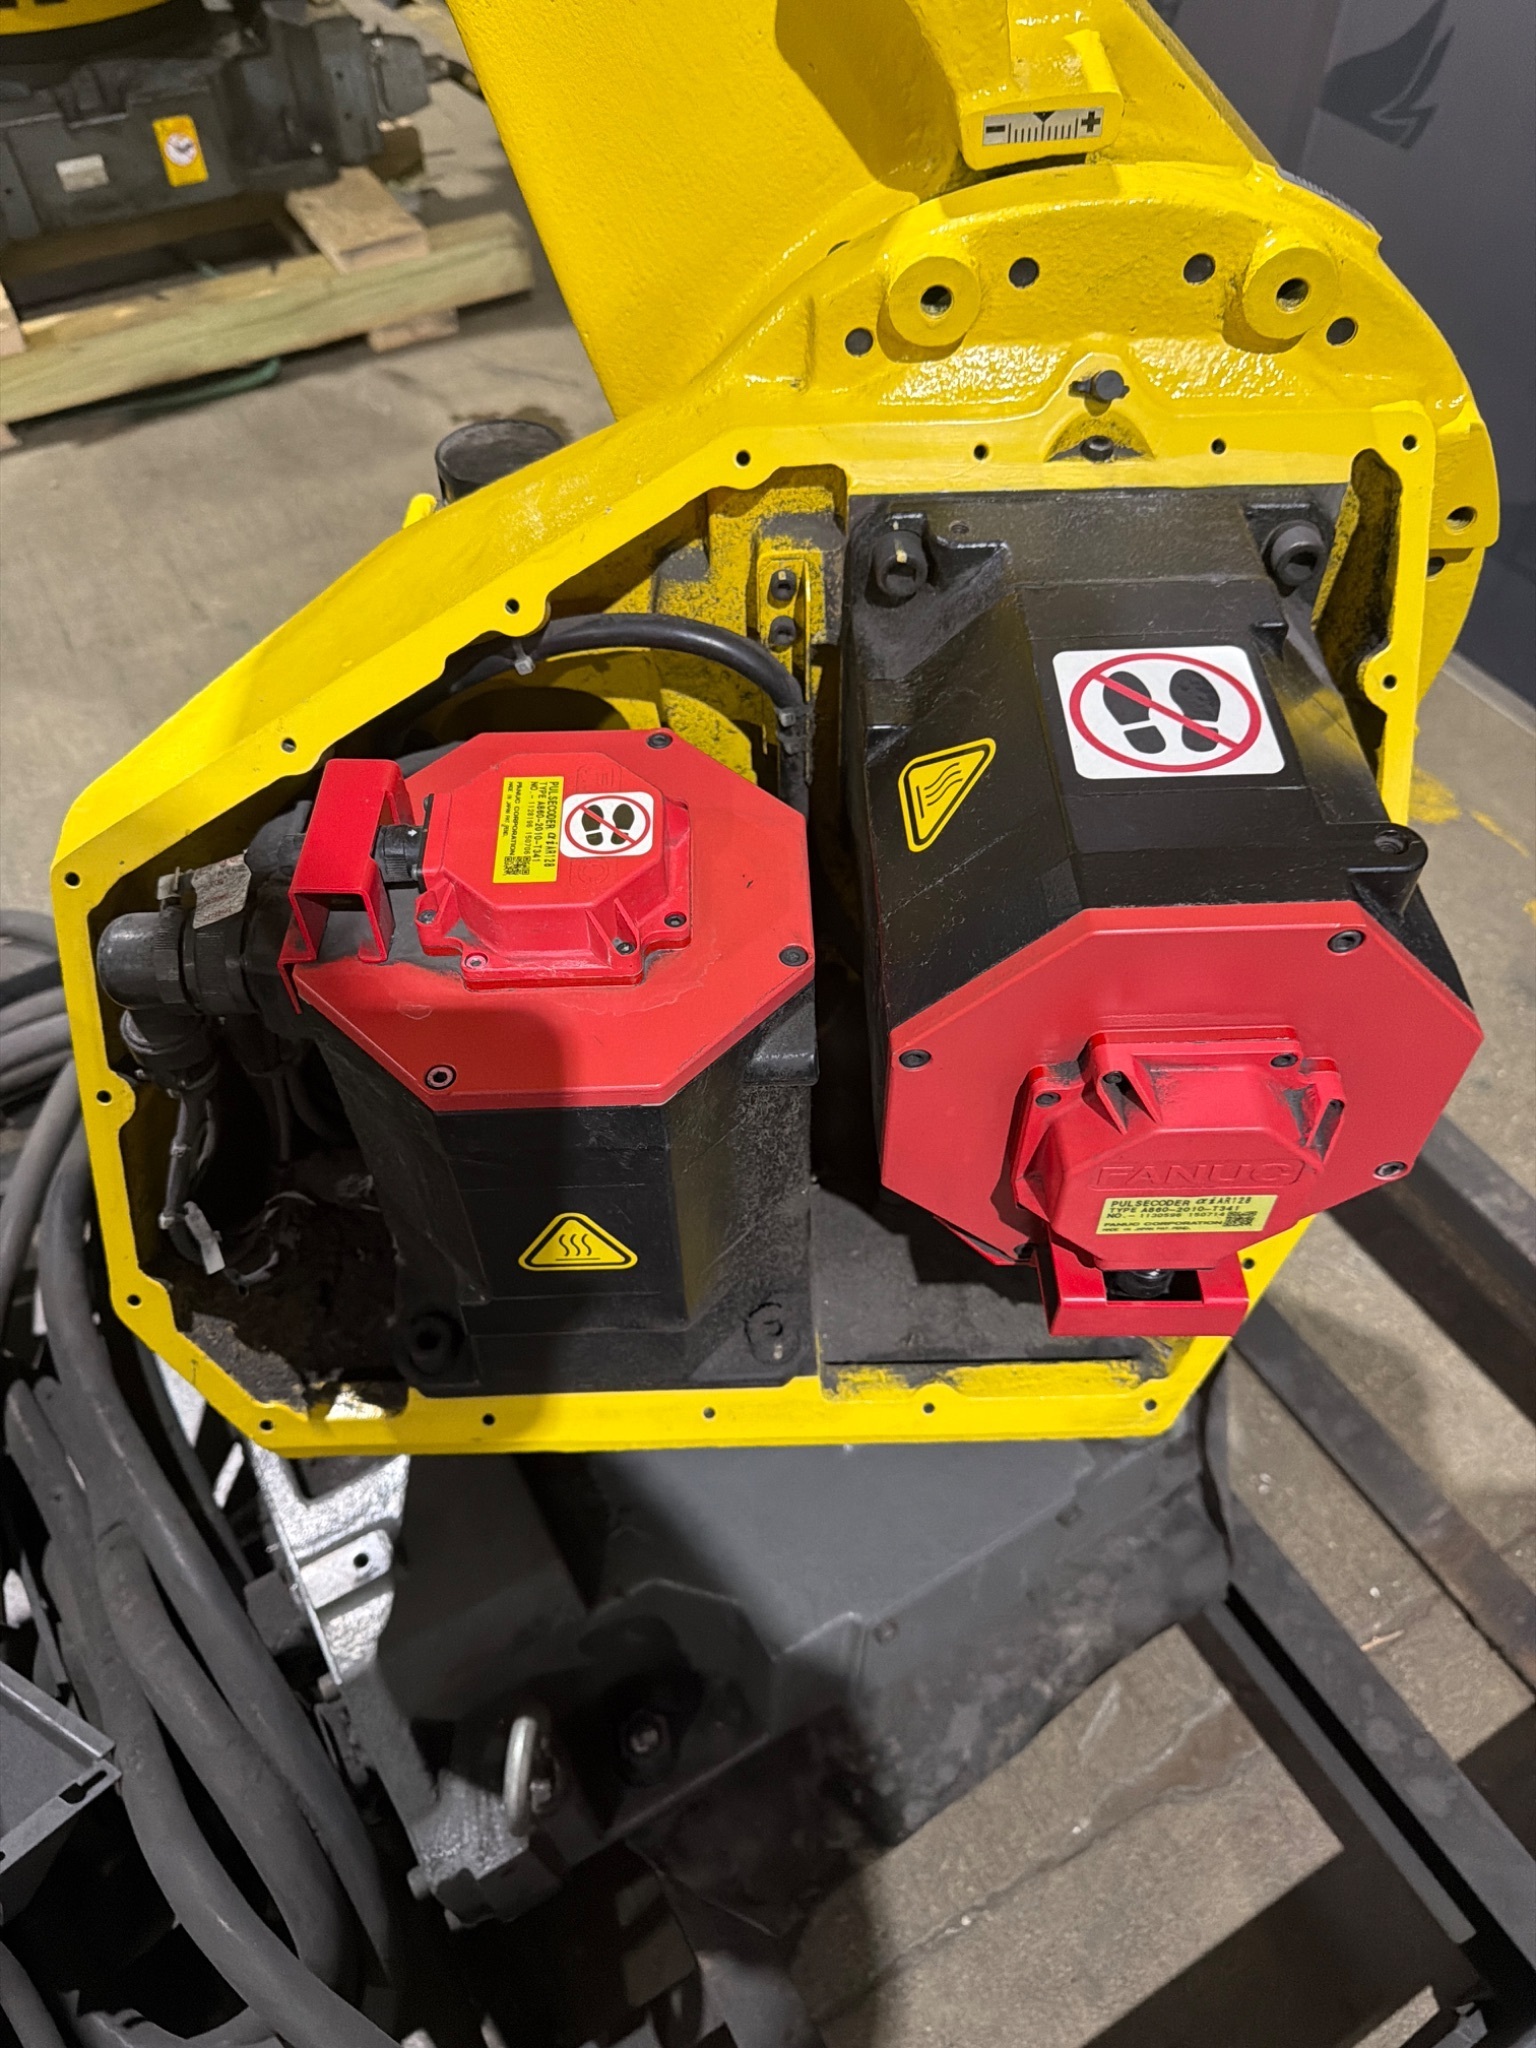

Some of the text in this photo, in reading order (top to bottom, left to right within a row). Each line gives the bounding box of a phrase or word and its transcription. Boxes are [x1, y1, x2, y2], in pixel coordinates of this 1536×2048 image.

[532, 781, 547, 862] TYPE A860-2010-T341
[546, 781, 559, 829] PULSECODER
[509, 806, 520, 855] CORPORATION
[1098, 1164, 1291, 1186] FANUC
[1110, 1199, 1191, 1207] PULSECODER
